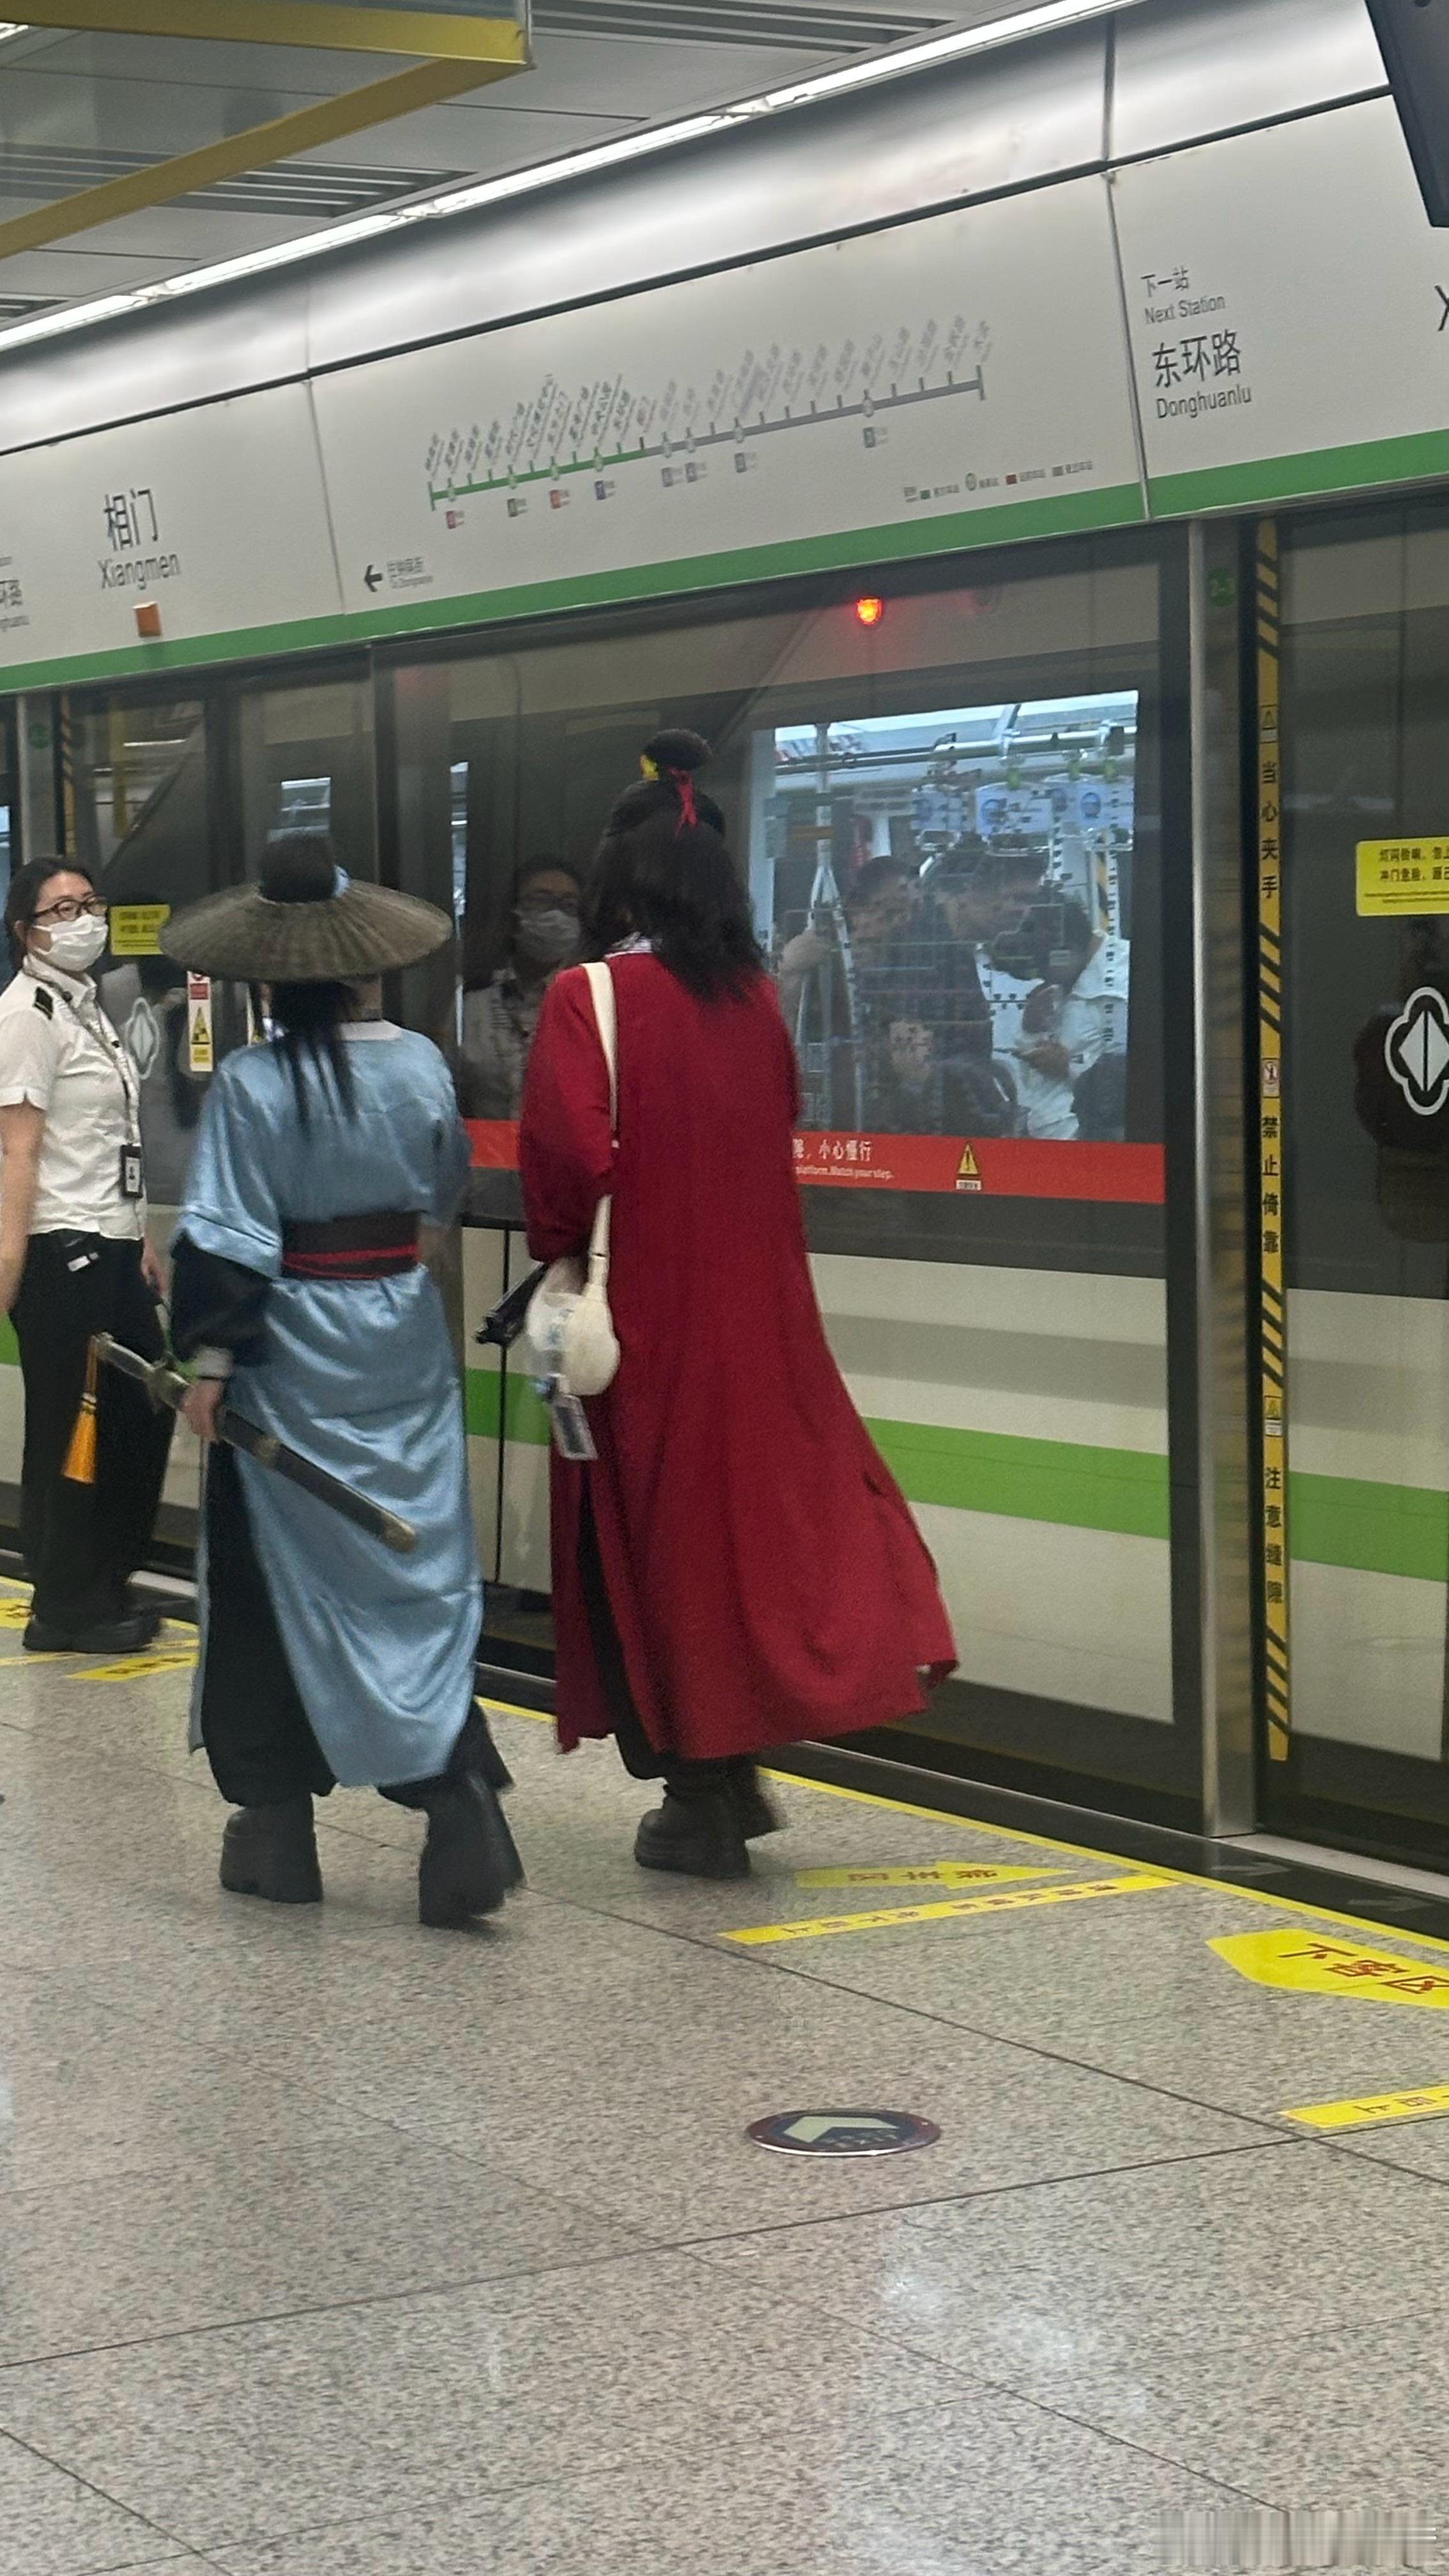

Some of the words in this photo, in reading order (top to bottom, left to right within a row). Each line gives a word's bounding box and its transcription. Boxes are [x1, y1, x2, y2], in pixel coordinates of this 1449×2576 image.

[1140, 266, 1190, 298] 下一站
[1144, 303, 1174, 325] Next
[1178, 294, 1225, 318] Station
[1152, 329, 1241, 388] 东环路
[1156, 383, 1252, 419] Donghuanlu
[103, 487, 159, 551] 相门
[97, 553, 181, 590] Xiangmen
[1262, 1116, 1279, 1254] 禁止倚靠
